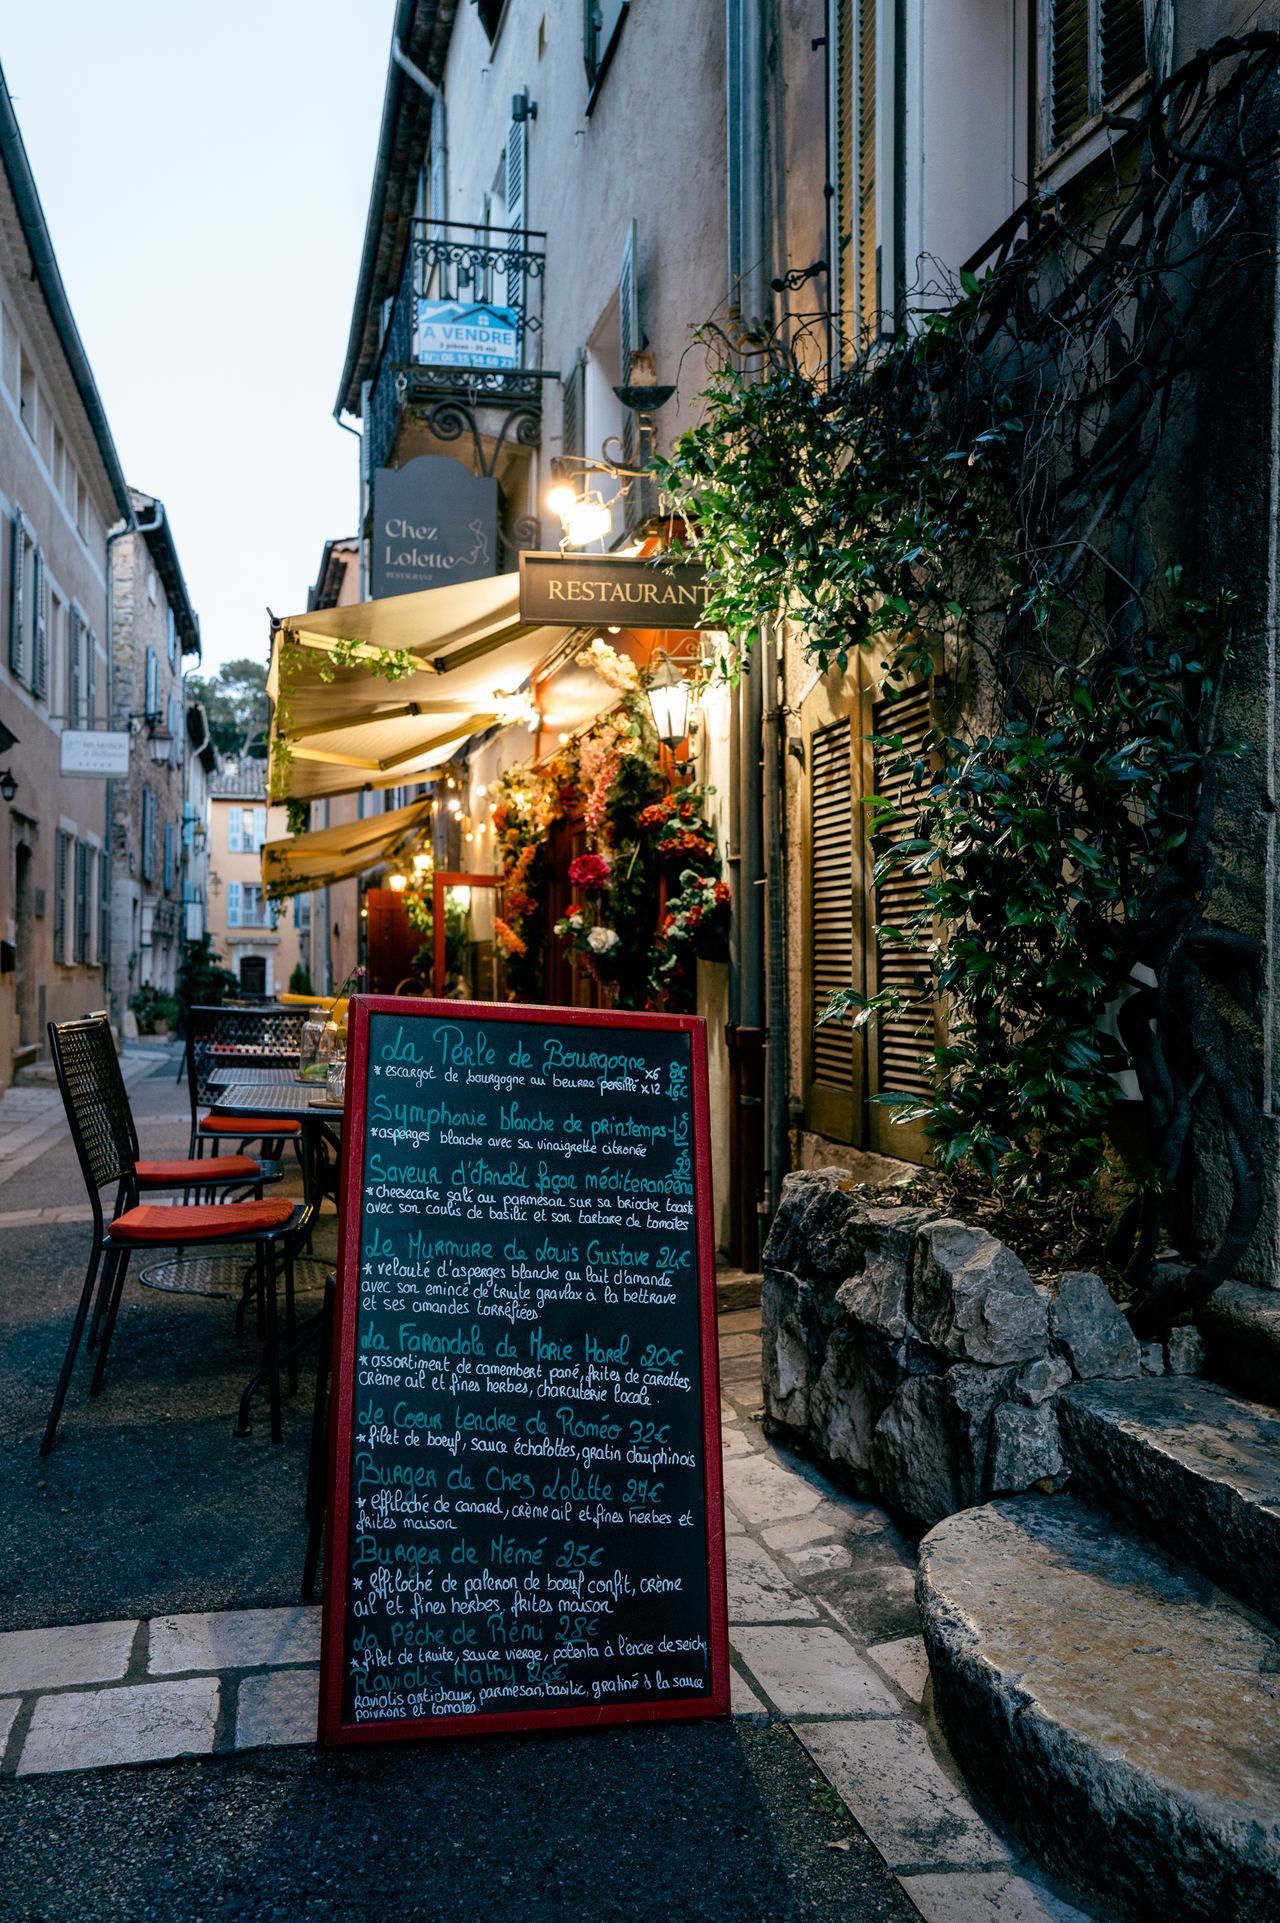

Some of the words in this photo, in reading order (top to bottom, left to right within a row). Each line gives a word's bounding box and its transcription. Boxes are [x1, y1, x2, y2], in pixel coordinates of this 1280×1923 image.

[424, 327, 436, 338] A
[443, 327, 512, 345] VENDRE
[384, 518, 438, 541] Chez
[385, 546, 455, 569] Lolette
[548, 580, 714, 605] RESTAURANT
[381, 1026, 423, 1064] La
[432, 1025, 495, 1065] Perle
[508, 1040, 533, 1068] de
[542, 1039, 646, 1085] Bourgogne
[385, 1065, 437, 1088] escargot
[444, 1067, 459, 1082] de
[466, 1069, 526, 1092] bourgogne
[530, 1077, 546, 1086] au
[553, 1073, 595, 1089] beurre
[600, 1076, 640, 1097] persillé
[371, 1094, 488, 1135] Symphonie
[500, 1102, 554, 1131] blanche
[563, 1113, 582, 1133] de
[591, 1116, 667, 1146] printemps
[379, 1127, 430, 1148] asperges
[440, 1129, 483, 1146] blanche
[488, 1138, 512, 1149] avec
[517, 1139, 533, 1150] sa
[537, 1138, 597, 1159] vinaigrette
[602, 1140, 647, 1157] citronée
[370, 1154, 443, 1185] Saveur
[535, 1161, 578, 1197] façon
[447, 1186, 474, 1204] salé
[478, 1194, 496, 1204] au
[503, 1195, 566, 1211] parmesan
[570, 1197, 592, 1208] sur
[597, 1198, 612, 1208] sa
[618, 1196, 661, 1213] brioche
[366, 1202, 394, 1214] avec
[399, 1203, 421, 1214] son
[426, 1202, 462, 1217] coulis
[467, 1205, 483, 1220] de
[490, 1206, 528, 1221] basilic
[533, 1209, 547, 1222] et
[552, 1211, 572, 1223] son
[578, 1210, 622, 1226] tartare
[626, 1213, 641, 1228] de
[647, 1214, 689, 1231] tomates
[365, 1228, 396, 1257] Le
[408, 1229, 494, 1260] Murmure
[504, 1238, 528, 1260] de
[535, 1237, 579, 1263] Louis
[587, 1239, 650, 1266] Gustave
[656, 1246, 691, 1270] 24€
[378, 1257, 430, 1278] velouté
[437, 1260, 506, 1287] d'asperges
[512, 1263, 559, 1281] blanche
[565, 1271, 581, 1281] au
[586, 1265, 609, 1284] lait
[614, 1269, 673, 1287] d'amande
[361, 1281, 391, 1294] avec
[397, 1282, 420, 1294] son
[425, 1281, 469, 1296] emincé
[473, 1283, 489, 1299] de
[493, 1281, 531, 1299] truite
[536, 1283, 583, 1309] gravlax
[586, 1288, 597, 1302] à
[604, 1285, 619, 1303] la
[623, 1287, 677, 1305] bettrave
[362, 1295, 377, 1311] et
[383, 1298, 406, 1311] ses
[412, 1299, 470, 1315] amandes
[361, 1320, 390, 1350] La
[398, 1323, 486, 1356] Farandole
[495, 1332, 518, 1358] de
[530, 1326, 573, 1362] Marie
[585, 1333, 630, 1366] Harel
[640, 1344, 684, 1367] 20€
[371, 1354, 451, 1372] assortiment
[456, 1357, 472, 1374] de
[476, 1363, 542, 1380] camembert
[585, 1364, 621, 1388] frites
[625, 1368, 640, 1383] de
[643, 1371, 691, 1392] carottes,
[405, 1369, 426, 1390] ail
[432, 1374, 445, 1390] et
[449, 1373, 480, 1396] fines
[486, 1377, 533, 1398] herbes,
[537, 1379, 608, 1402] charcuterie
[358, 1399, 385, 1425] Le
[455, 1405, 518, 1432] tendre
[525, 1410, 548, 1435] de
[556, 1407, 622, 1440] Roméo
[629, 1420, 670, 1444] 32€
[368, 1425, 399, 1450] filet
[405, 1429, 420, 1446] de
[471, 1438, 508, 1454] sauce
[514, 1437, 580, 1461] échalottes,
[582, 1444, 621, 1469] gratin
[626, 1445, 696, 1472] dauphinois
[355, 1452, 437, 1503] Burger
[447, 1464, 475, 1490] de
[486, 1466, 535, 1499] Chez
[542, 1467, 613, 1501] Lolette
[622, 1478, 664, 1504] 27€
[356, 1509, 397, 1534] frites
[403, 1516, 458, 1530] maison
[371, 1489, 429, 1517] effiloché
[434, 1494, 450, 1513] de
[455, 1497, 509, 1520] canard,
[511, 1502, 549, 1518] crème
[551, 1502, 572, 1521] ail
[579, 1505, 592, 1521] et
[592, 1503, 623, 1529] fines
[629, 1509, 672, 1524] herbes
[678, 1510, 694, 1526] et
[352, 1535, 441, 1578] Burger
[451, 1538, 479, 1564] de
[490, 1534, 548, 1565] Mémé
[556, 1540, 604, 1568] 25€
[370, 1566, 434, 1600] effiloché
[441, 1573, 457, 1593] de
[464, 1568, 518, 1600] paleron
[523, 1570, 540, 1590] de
[353, 1591, 377, 1617] ail
[386, 1595, 404, 1616] et
[410, 1590, 446, 1620] fines
[511, 1590, 553, 1618] frites
[558, 1598, 614, 1614] maison
[353, 1624, 379, 1652] La
[391, 1620, 445, 1647] Pêche
[452, 1619, 479, 1645] de
[487, 1613, 543, 1644] Rémi
[554, 1614, 599, 1641] 28€
[362, 1648, 393, 1672] filet
[398, 1648, 413, 1664] de
[418, 1647, 459, 1665] truite,
[463, 1649, 501, 1661] sauce
[553, 1641, 599, 1665] polenta
[604, 1641, 614, 1657] à
[618, 1634, 654, 1656] l'encre
[658, 1634, 675, 1652] de
[350, 1666, 442, 1695] Raviolis
[454, 1663, 515, 1687] Mathy
[592, 1672, 639, 1698] gratiné
[644, 1674, 652, 1690] à
[656, 1670, 670, 1690] la
[673, 1676, 704, 1689] sauce
[356, 1706, 407, 1722] poivrons
[412, 1704, 426, 1717] et
